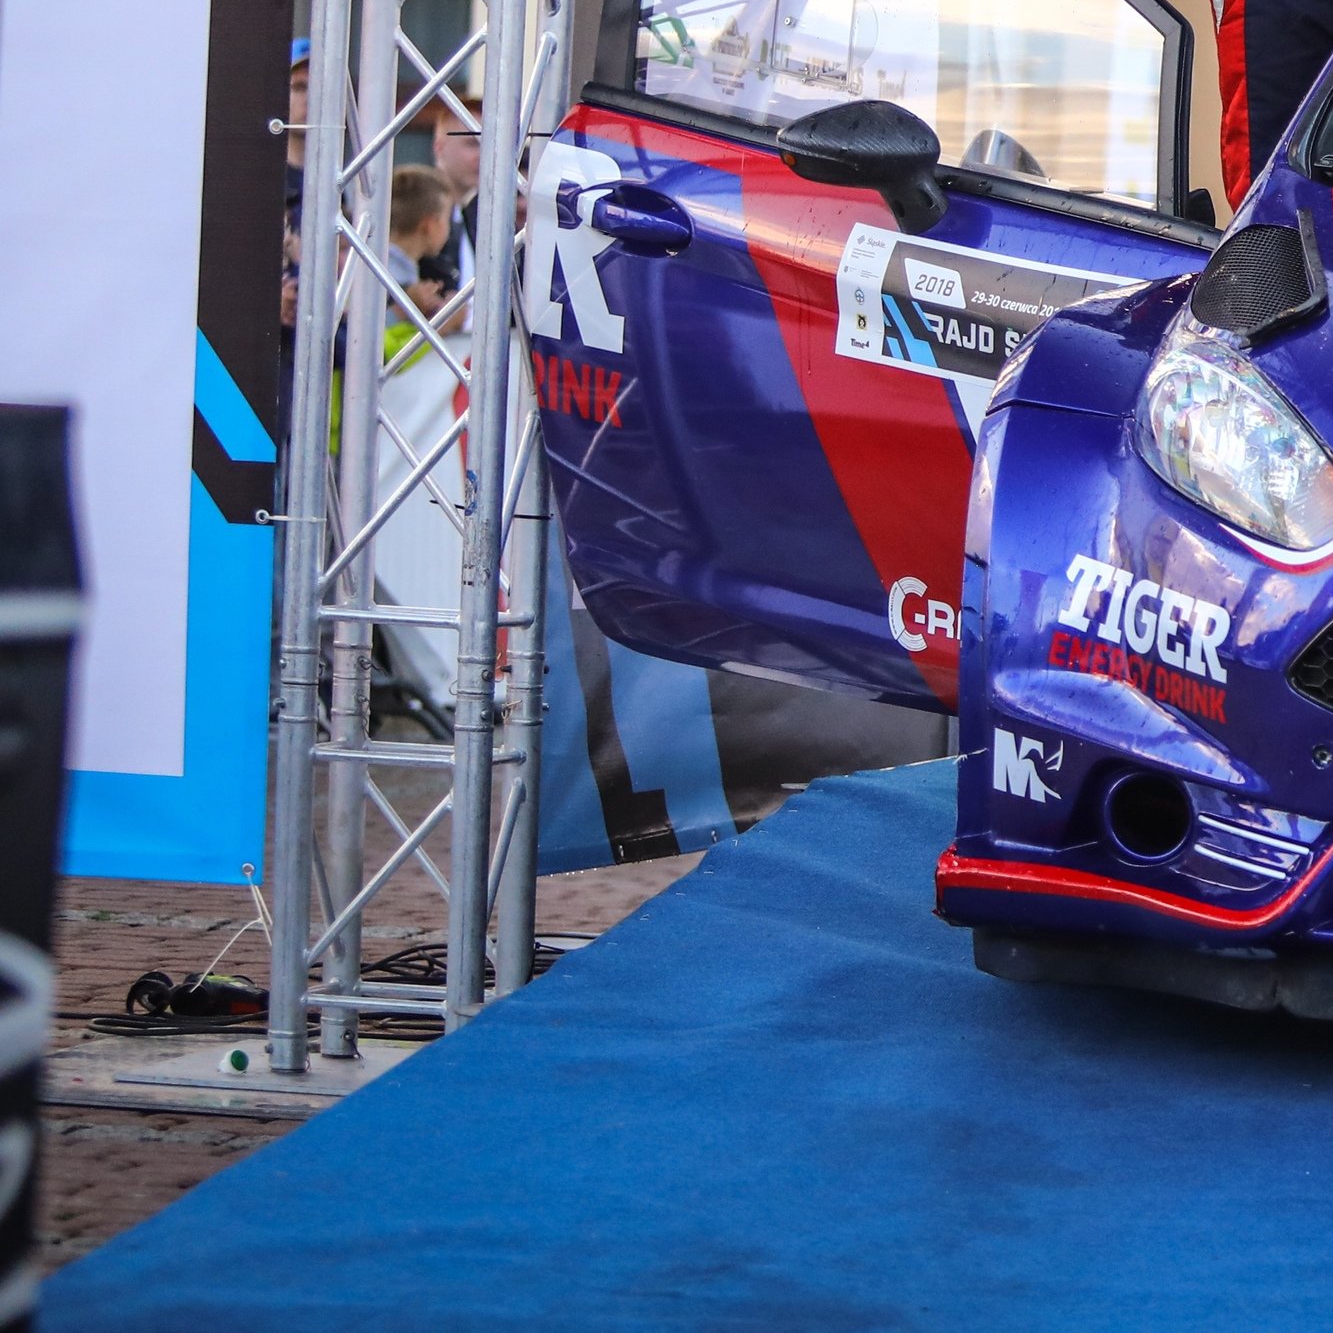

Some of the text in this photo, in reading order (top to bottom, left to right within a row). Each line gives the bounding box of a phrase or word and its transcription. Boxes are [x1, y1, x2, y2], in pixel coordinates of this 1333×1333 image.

[915, 273, 956, 297] 2018
[970, 290, 1039, 315] 29-30 czerwca
[923, 312, 994, 355] RAJD
[1059, 554, 1232, 685] TIGER
[1048, 631, 1227, 724] ENERGY DRINK
